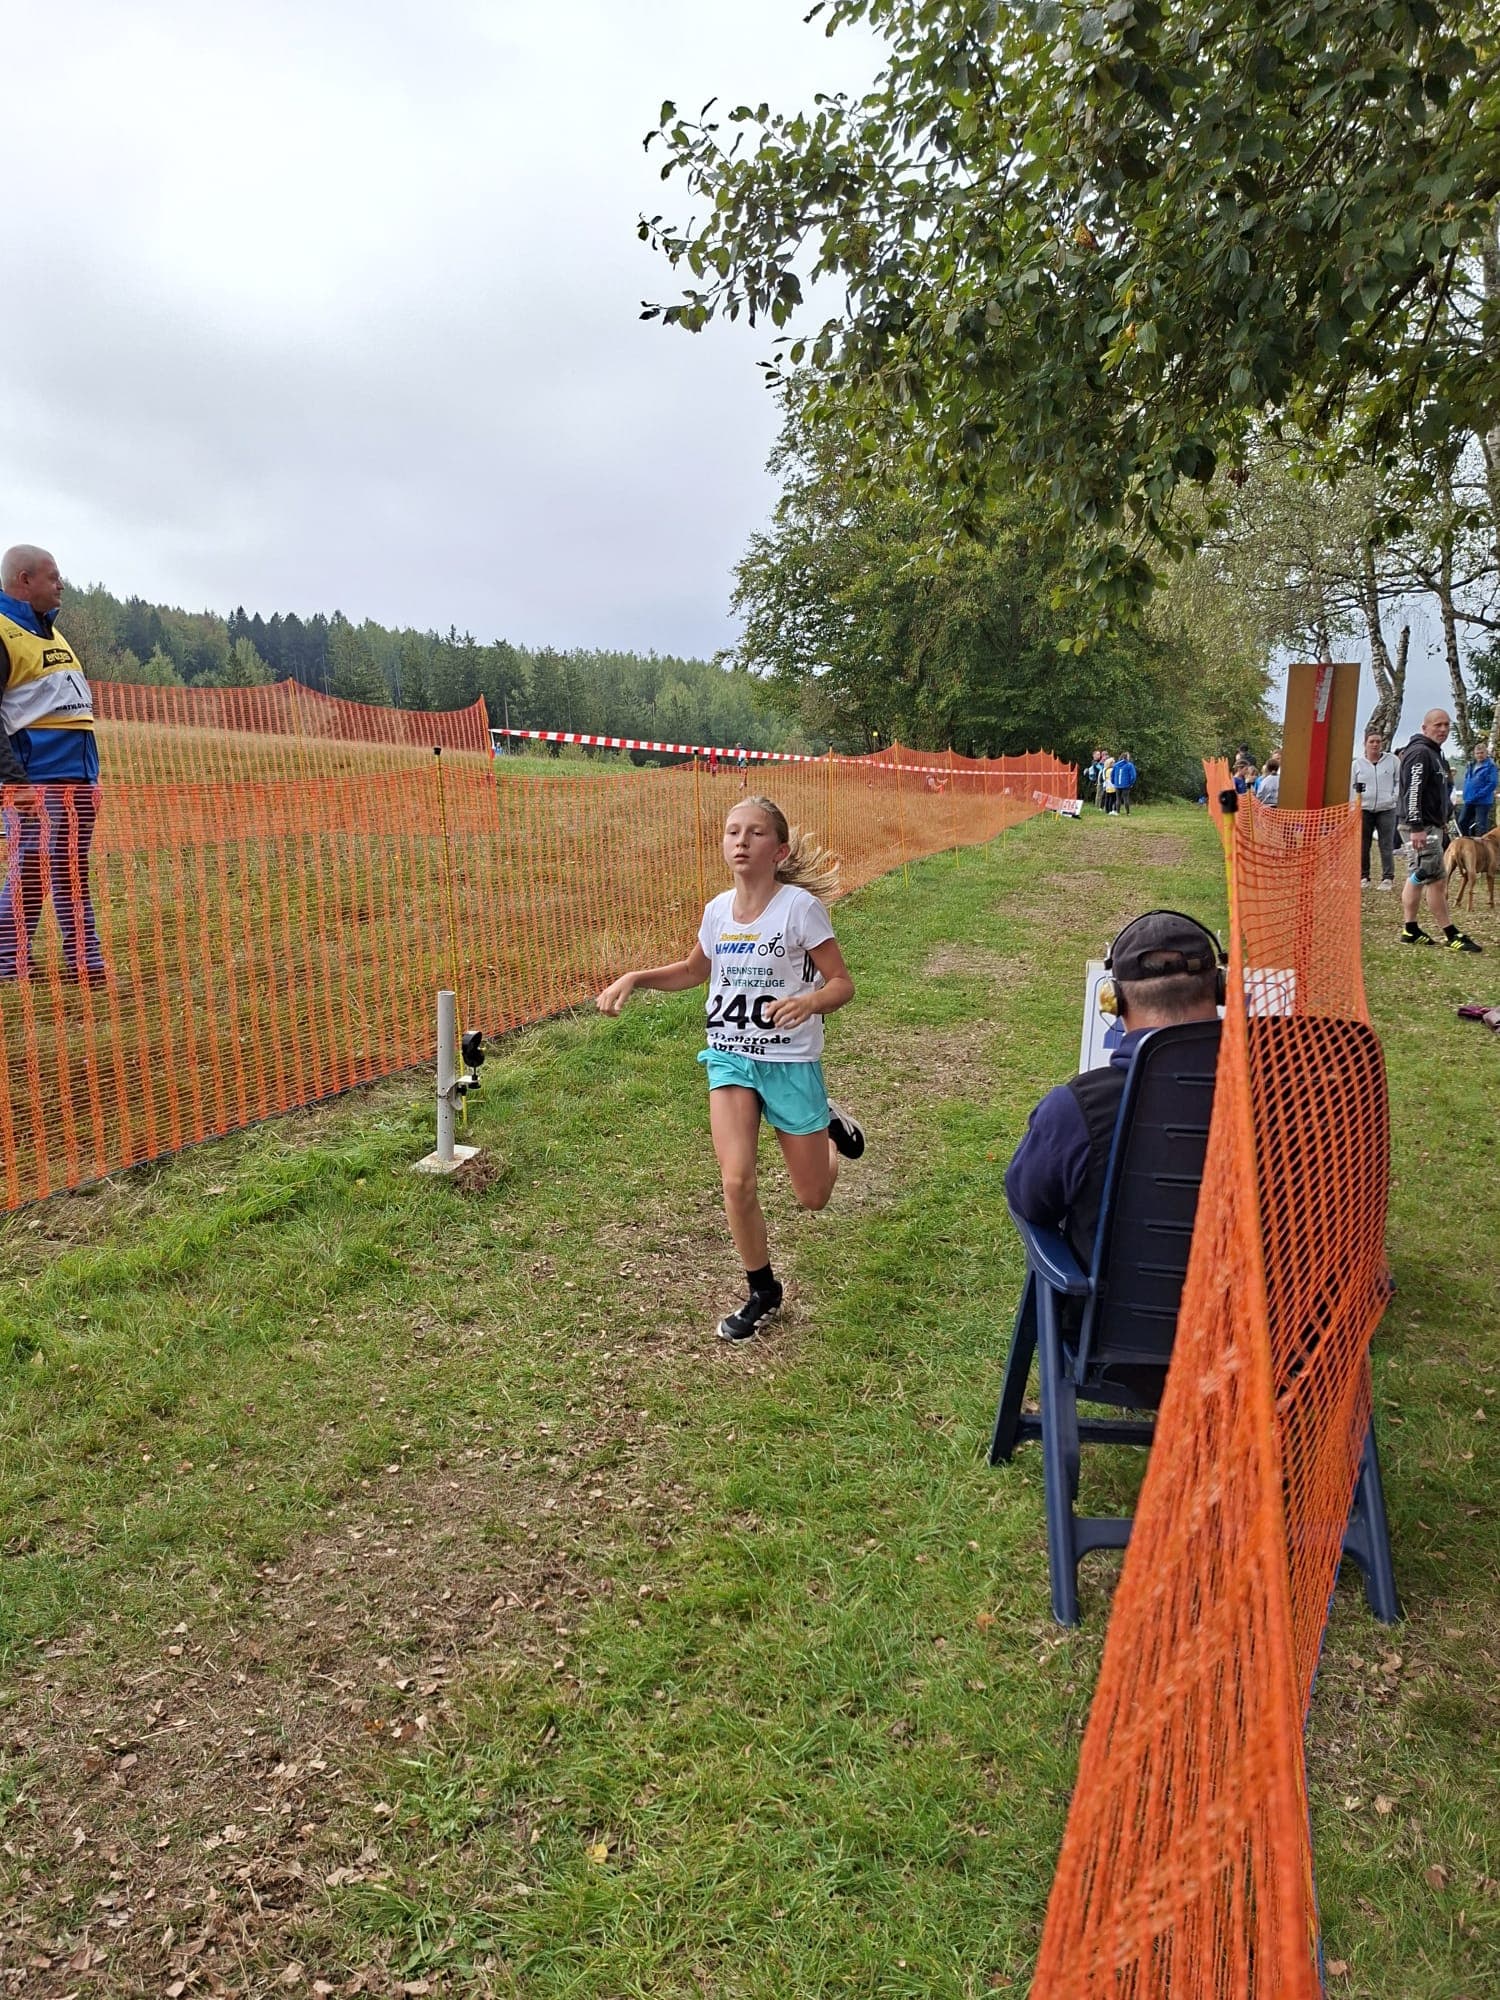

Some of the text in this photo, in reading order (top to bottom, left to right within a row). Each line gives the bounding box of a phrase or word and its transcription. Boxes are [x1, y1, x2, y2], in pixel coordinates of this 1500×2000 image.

[727, 966, 773, 976] RENNSTEIG
[732, 979, 785, 988] WERKZEUGE
[706, 994, 779, 1030] 240
[741, 1045, 766, 1056] Ski
